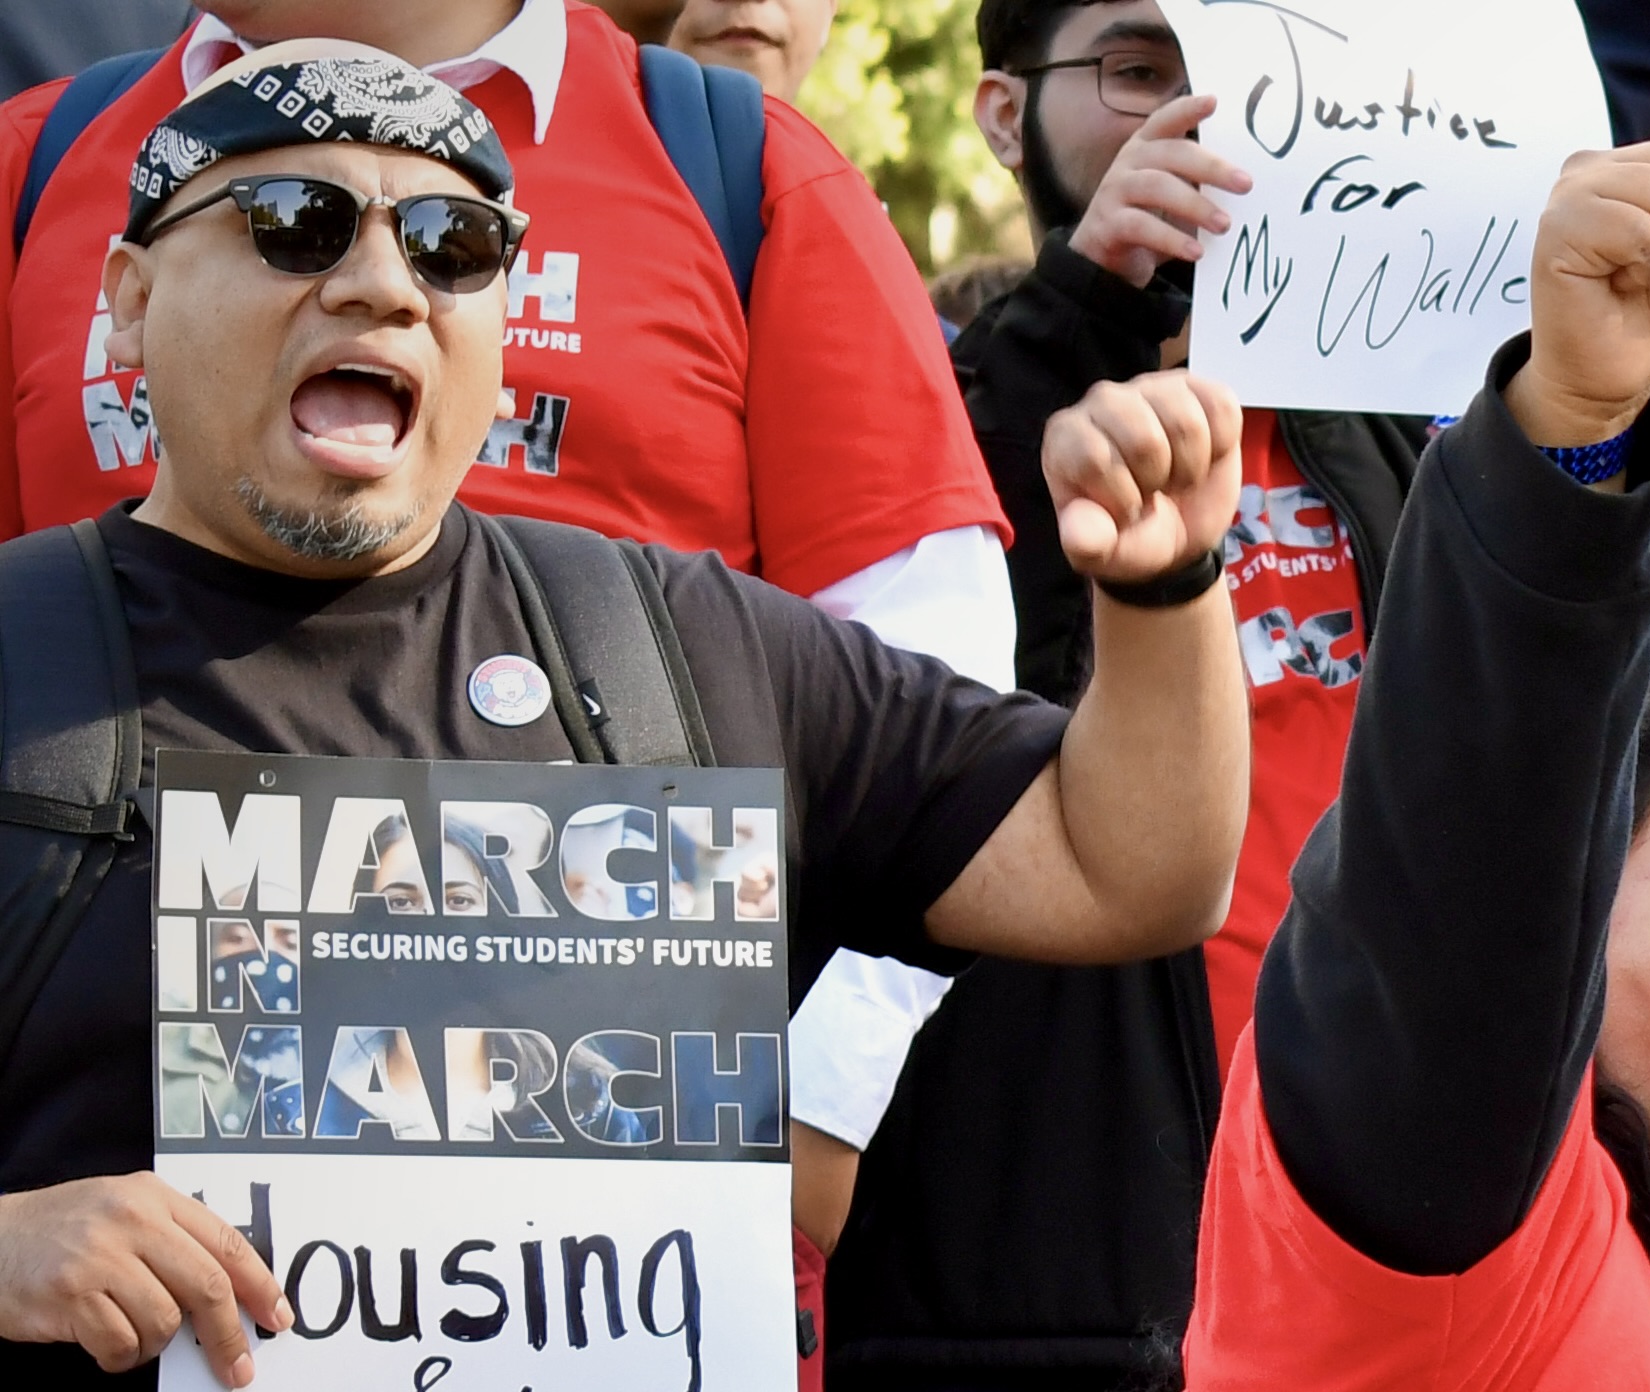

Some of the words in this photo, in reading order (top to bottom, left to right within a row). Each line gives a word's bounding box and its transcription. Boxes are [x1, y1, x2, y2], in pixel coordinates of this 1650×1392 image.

[1196, 0, 1518, 160] Justice
[500, 327, 582, 354] UTURE
[1222, 214, 1293, 346] My
[158, 789, 780, 923] MARCH
[157, 915, 301, 1014] IN
[311, 930, 469, 962] SECURING
[475, 934, 646, 966] STUDENTS'
[653, 937, 774, 969] FUTURE
[158, 1021, 784, 1149] MARCH
